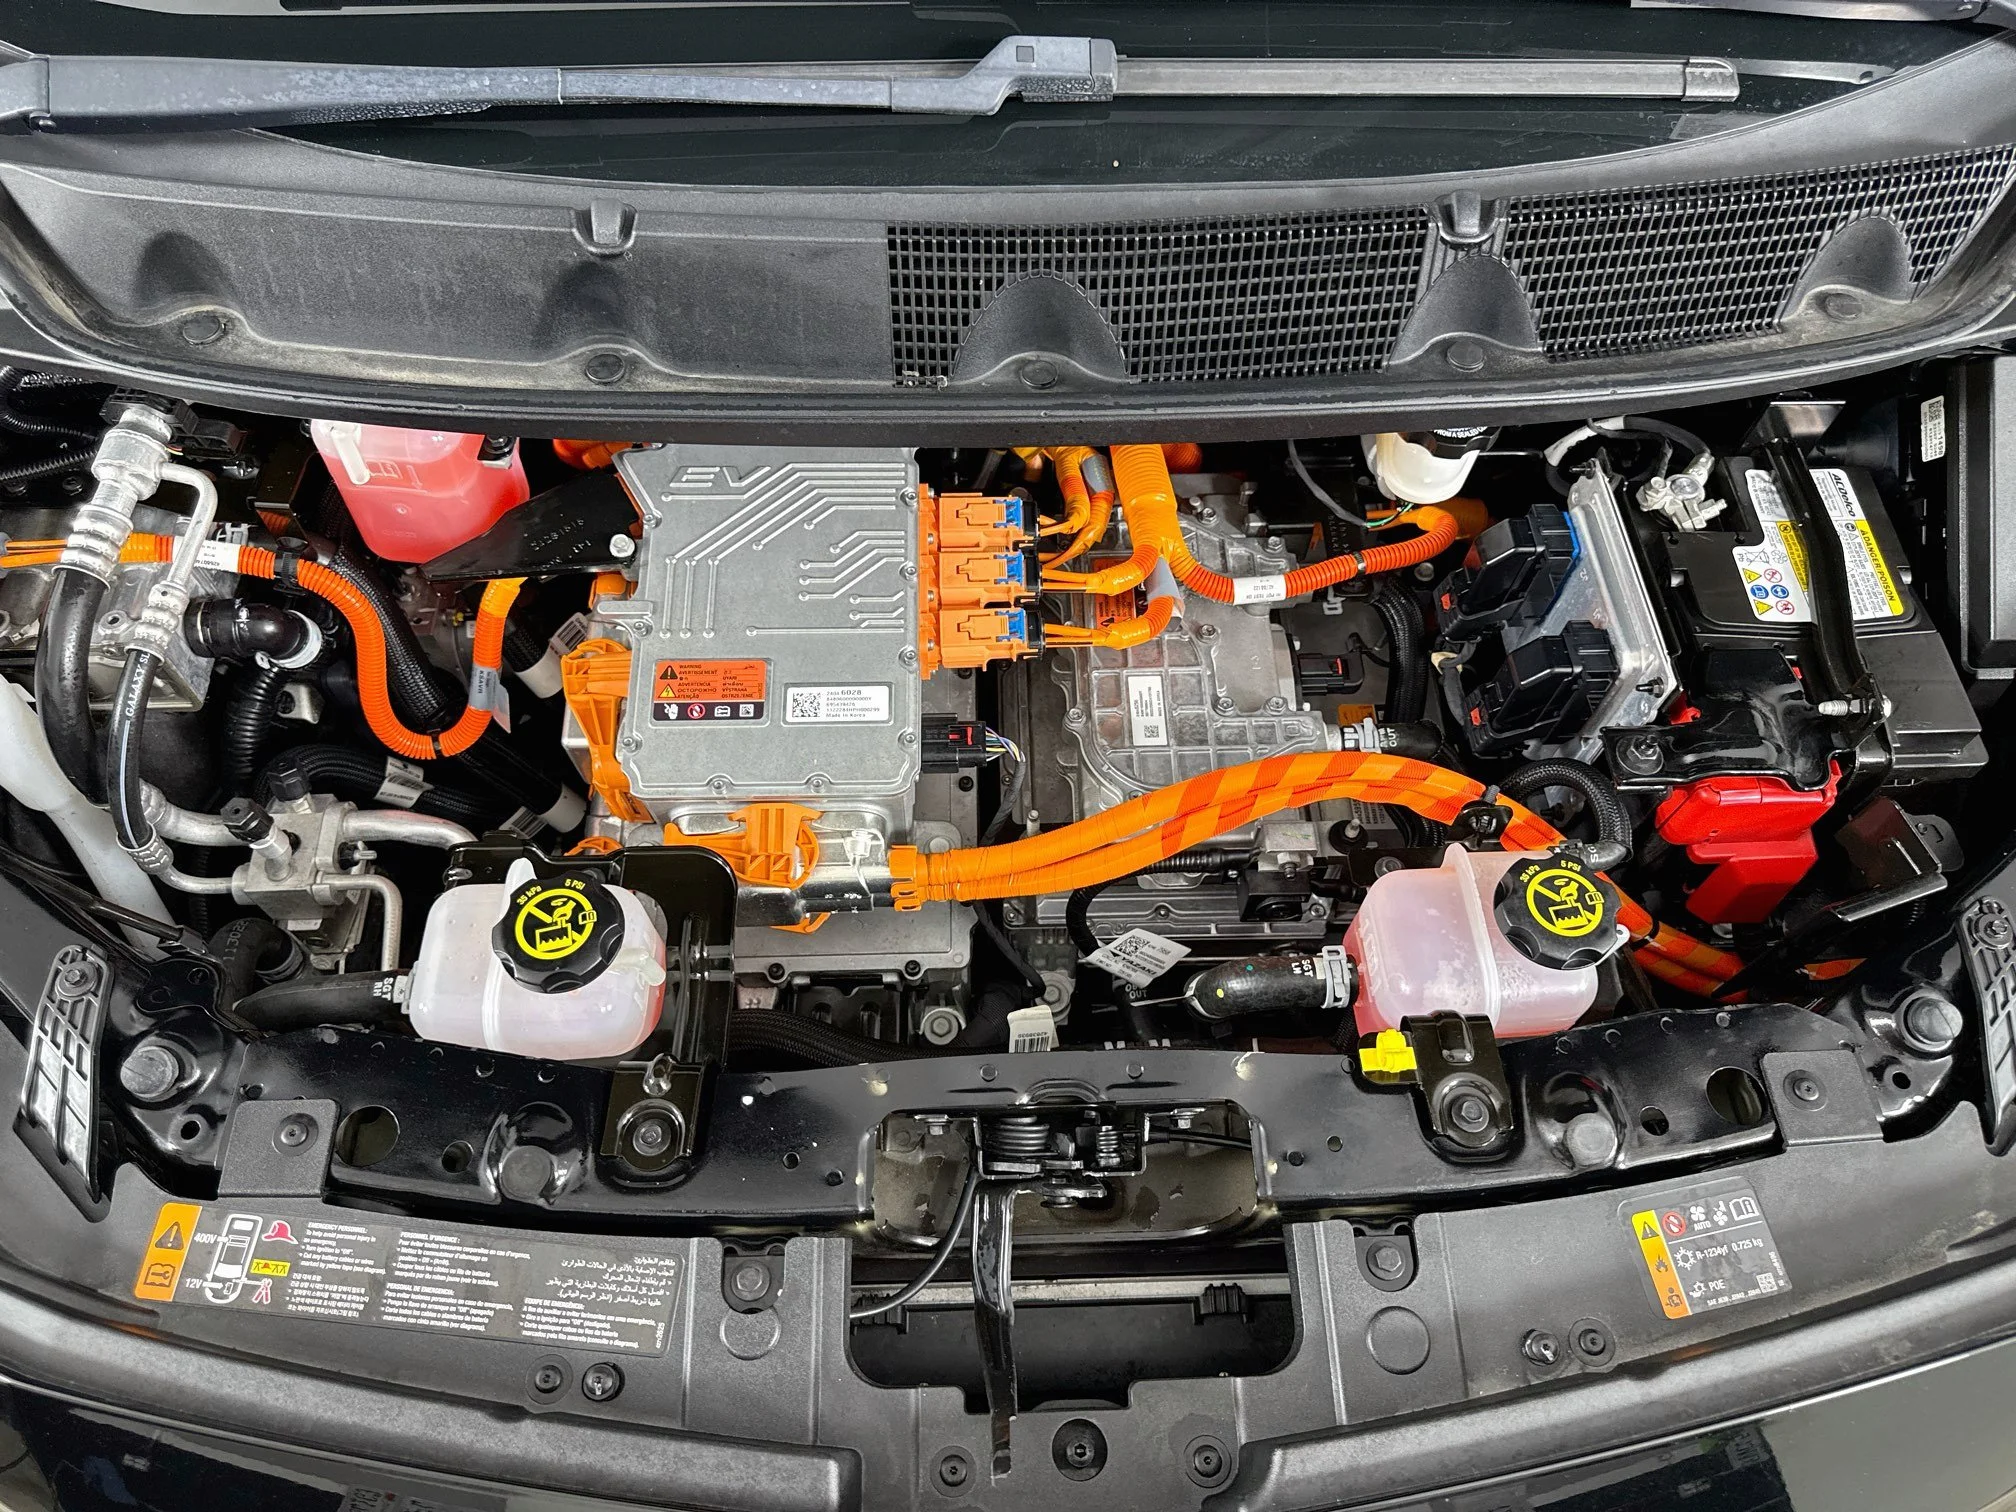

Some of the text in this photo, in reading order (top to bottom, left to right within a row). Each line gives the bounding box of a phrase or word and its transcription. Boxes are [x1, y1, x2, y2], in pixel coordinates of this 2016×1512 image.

[1456, 428, 1478, 438] SEALED
[1832, 472, 1856, 518] ACDelco
[125, 663, 145, 717] GALAXY
[1386, 727, 1398, 747] OUT
[1519, 860, 1581, 883] 35 kPa 5 PSI
[516, 878, 586, 906] 35 kPa 5 PSI
[1121, 956, 1157, 975] YAZAKI
[1291, 962, 1302, 975] LH
[1301, 959, 1314, 978] SGT
[373, 981, 383, 997] RH
[381, 977, 394, 1001] SGT
[1129, 989, 1148, 999] OUT
[306, 1228, 312, 1236] To
[307, 1222, 369, 1234] EMERGENCY PERSONNEL:
[1694, 1221, 1711, 1231] AUTO
[194, 1233, 218, 1244] 400V
[400, 1231, 429, 1240] PERSONNEL
[1695, 1237, 1764, 1260] R-1234yf 0.725 kg
[185, 1277, 203, 1289] 12V
[386, 1282, 412, 1292] PERSONAL
[1708, 1279, 1726, 1291] POE
